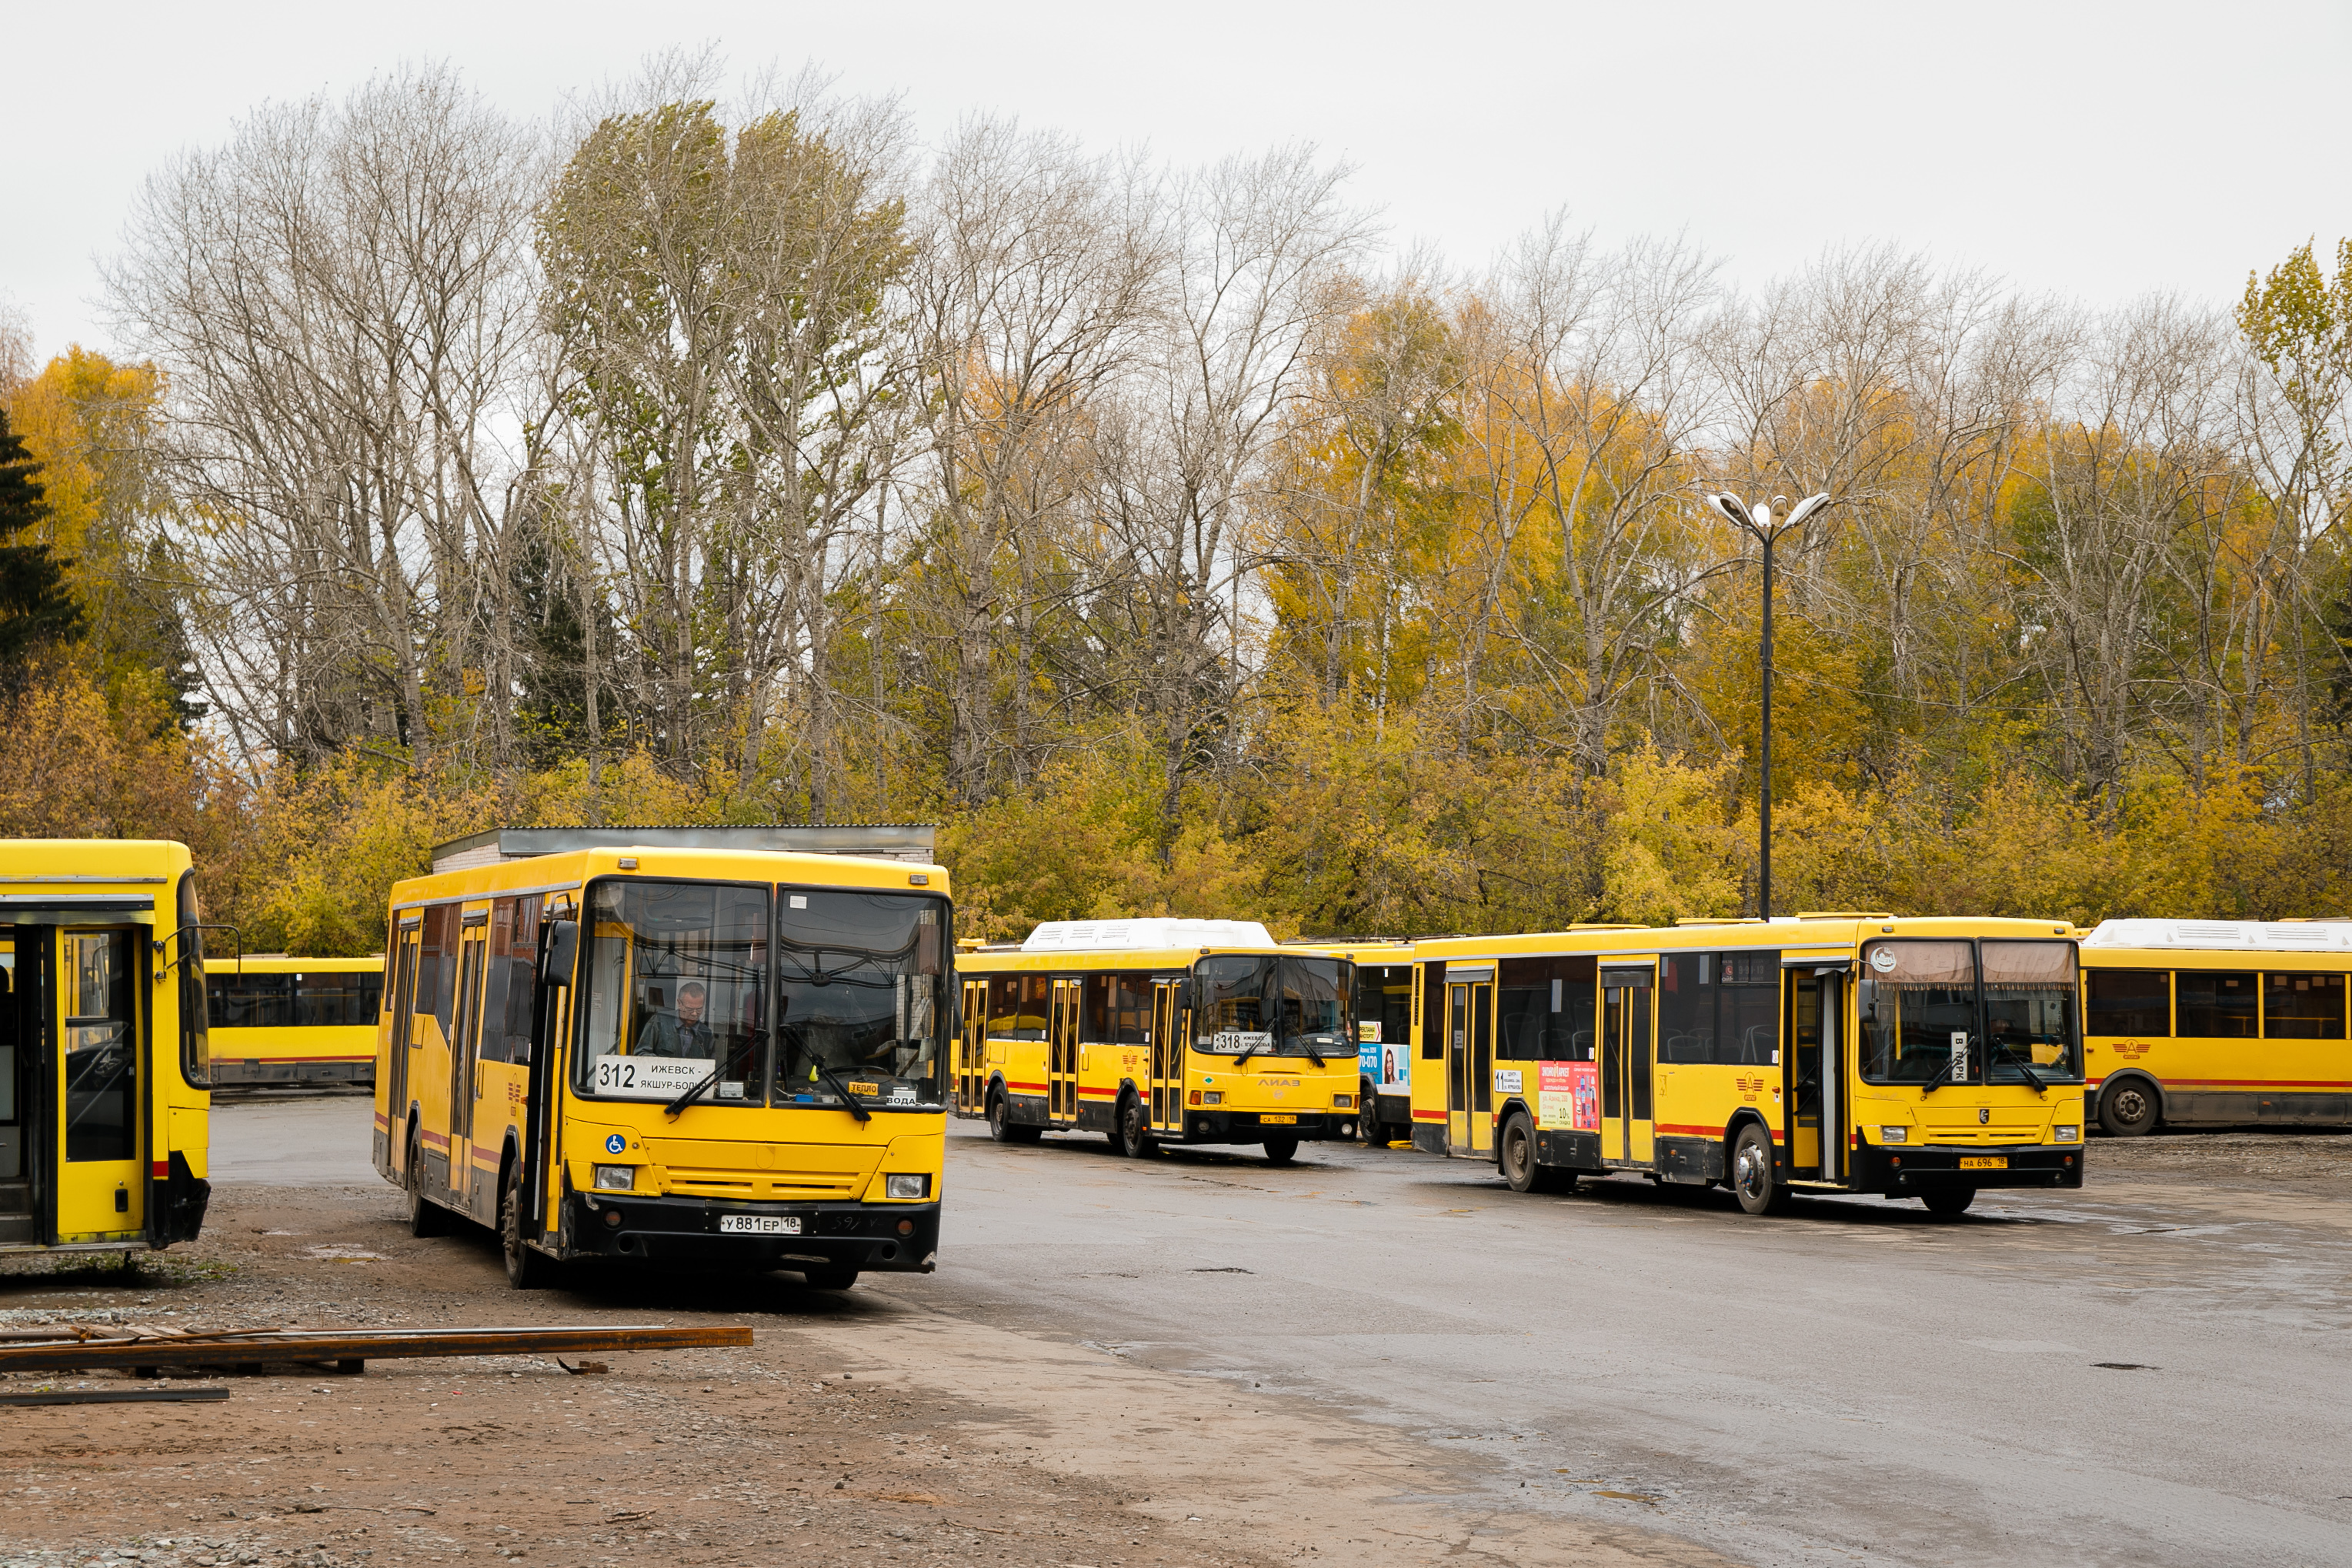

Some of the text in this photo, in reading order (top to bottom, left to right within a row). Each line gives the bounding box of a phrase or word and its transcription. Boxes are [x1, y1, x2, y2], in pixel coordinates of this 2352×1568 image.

[1221, 1035, 1239, 1048] 318
[599, 1063, 636, 1088] 312
[651, 1065, 695, 1074] ИЖЕВСК
[1496, 1072, 1503, 1089] 11
[852, 1083, 876, 1093] ТЕПЛО
[886, 1097, 916, 1106] ВОДА
[1977, 1158, 1992, 1167] 696
[783, 1218, 796, 1228] 18
